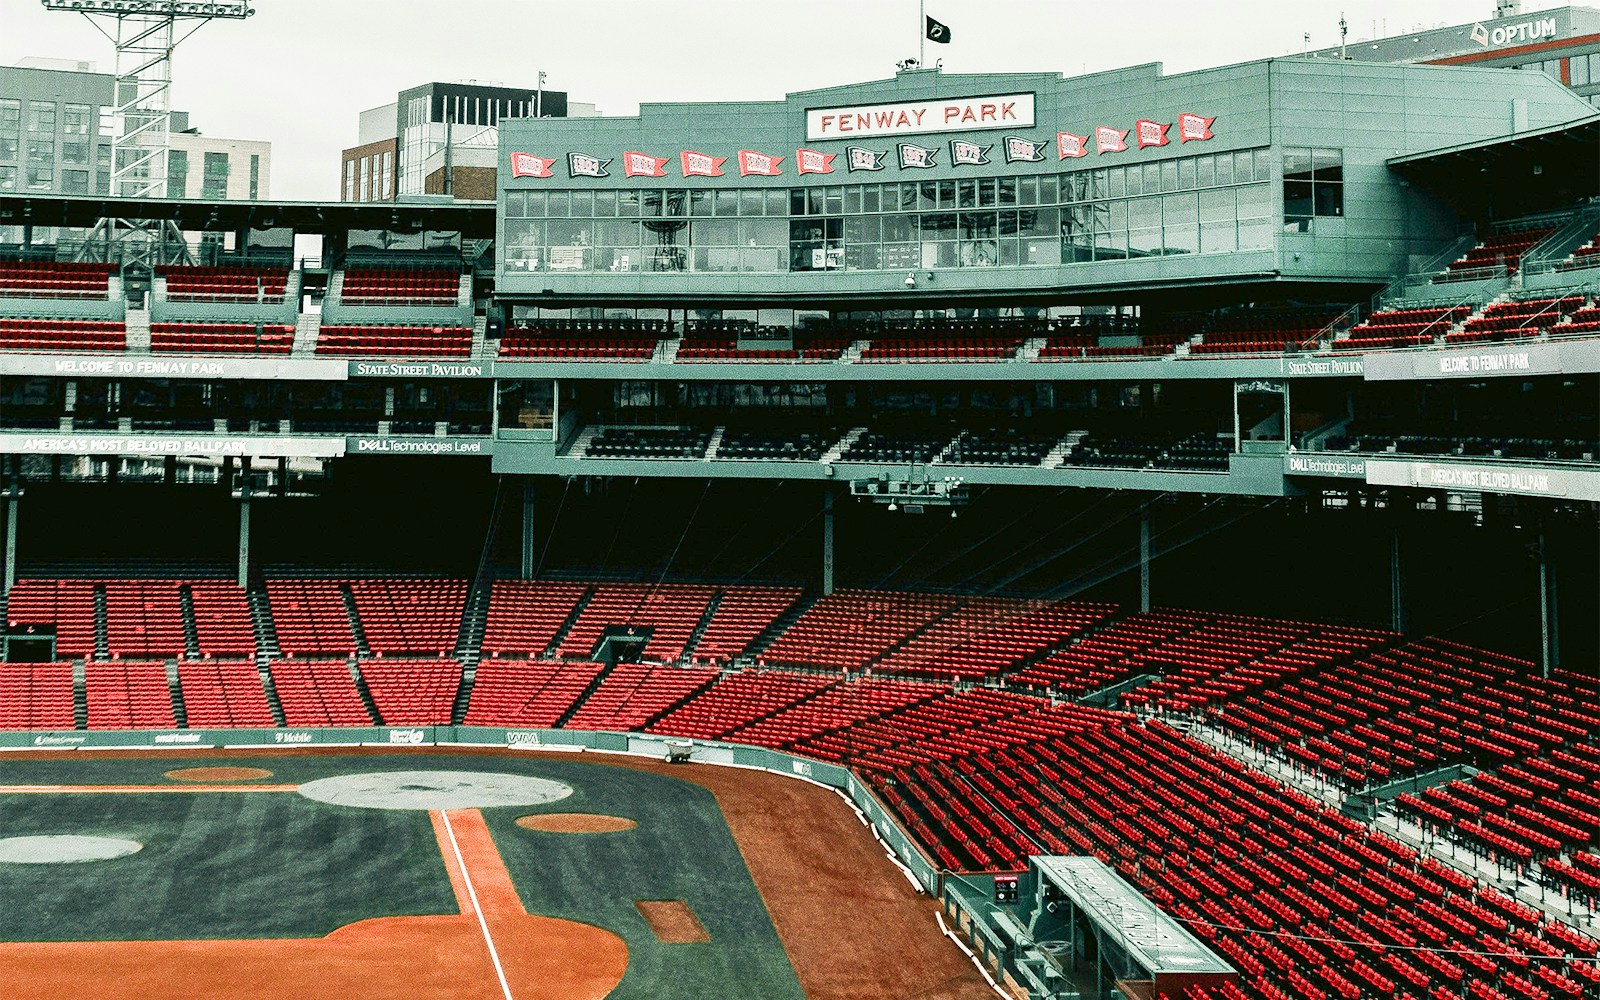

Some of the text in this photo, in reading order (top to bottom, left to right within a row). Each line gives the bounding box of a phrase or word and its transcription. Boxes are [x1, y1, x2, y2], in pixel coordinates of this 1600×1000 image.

[1492, 18, 1556, 44] OPTUM
[821, 101, 1017, 133] FENWAY PARK
[956, 145, 980, 159] 1975
[55, 359, 225, 374] WELCOME TO FENWAY PARK
[357, 363, 481, 376] STATE STREET PAVILION
[1288, 360, 1364, 375] STATE STREET PAVILION
[1440, 353, 1529, 373] WELCOME TO FENWAY PARK
[23, 438, 248, 453] AMERICA'S MOST BELOVED BALLPARK
[455, 440, 481, 453] Level
[1348, 460, 1365, 474] Level
[1462, 471, 1479, 486] MOST
[1481, 472, 1510, 489] BELOVED
[1512, 473, 1549, 492] BALLPARK
[284, 732, 312, 743] Mobile
[507, 732, 539, 743] WM
